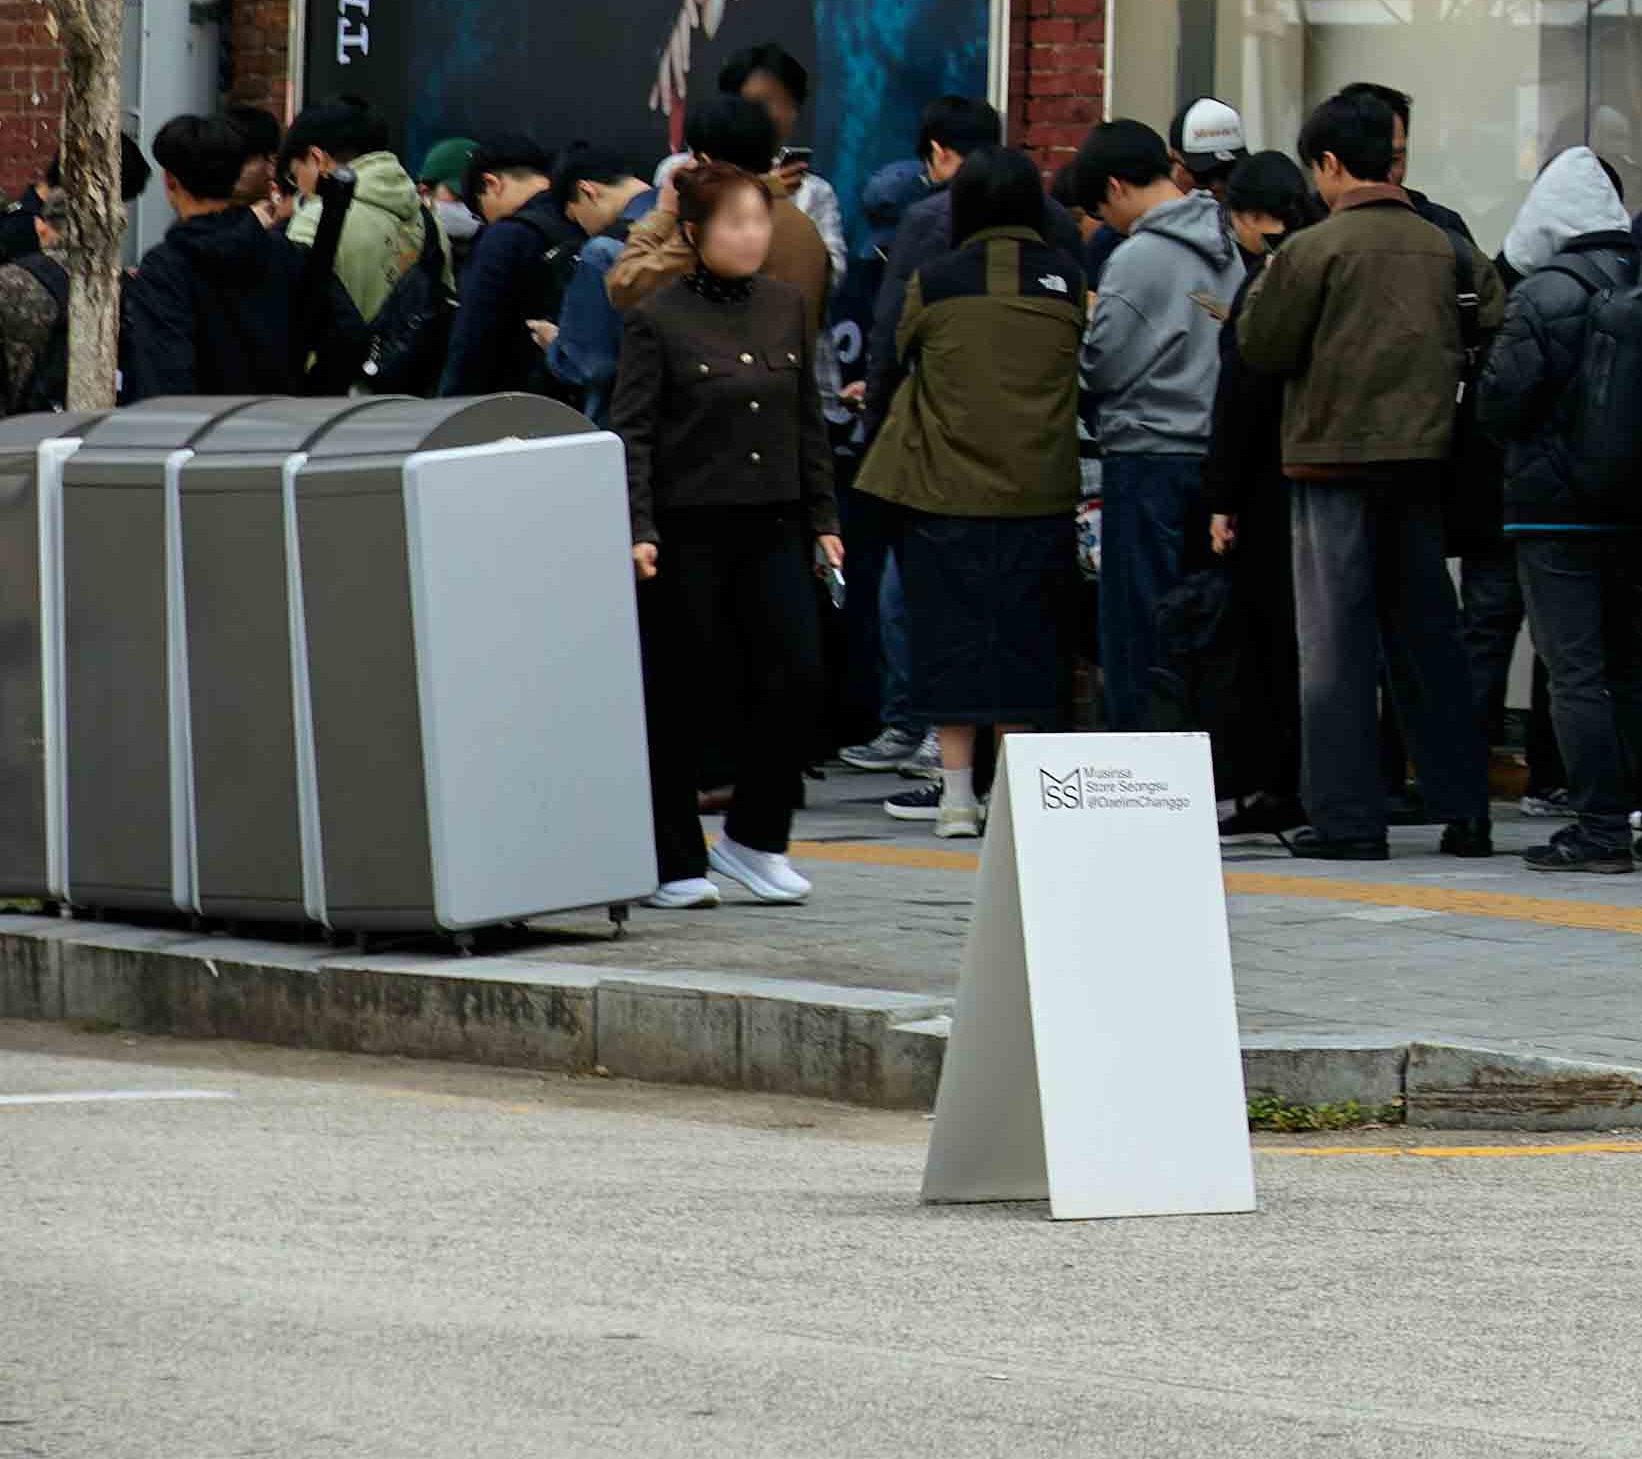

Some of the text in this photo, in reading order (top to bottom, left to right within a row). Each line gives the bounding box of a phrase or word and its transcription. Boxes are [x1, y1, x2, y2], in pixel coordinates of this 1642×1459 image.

[1083, 766, 1133, 778] Musinsa
[1085, 781, 1169, 795] Store Seongsu
[1088, 795, 1191, 811] @DaelimChanggo
